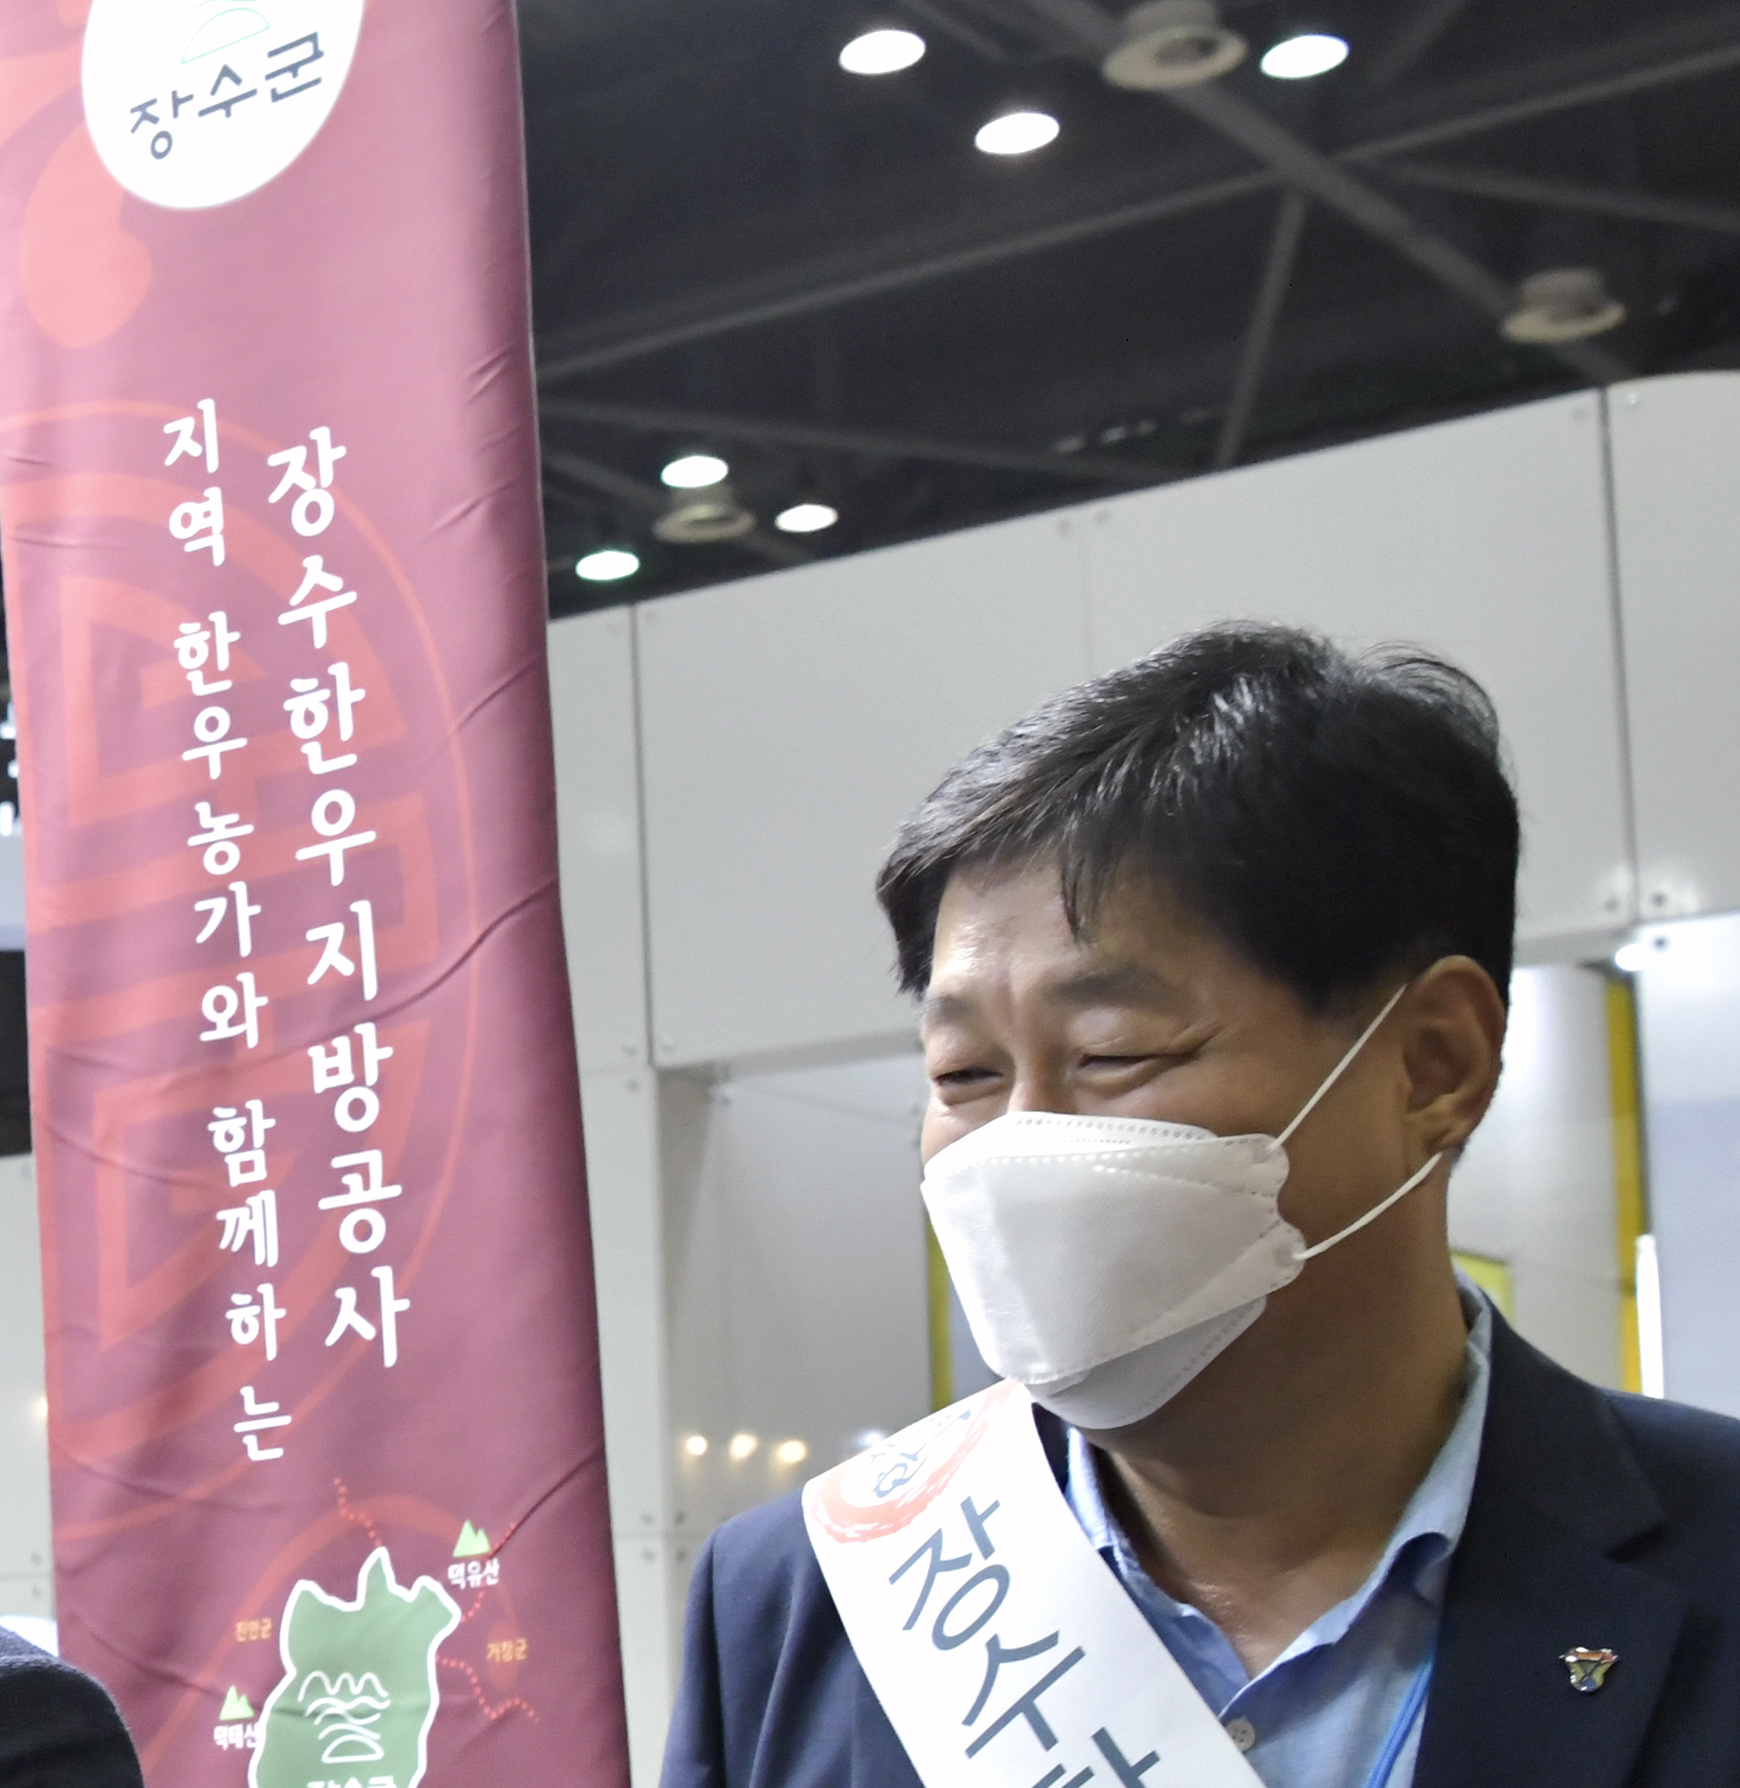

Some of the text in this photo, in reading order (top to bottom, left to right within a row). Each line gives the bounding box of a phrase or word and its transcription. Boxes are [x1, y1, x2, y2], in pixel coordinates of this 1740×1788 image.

[130, 31, 324, 160] 장수군
[163, 398, 292, 1461] 지역 한우농가와 함께하는
[268, 426, 410, 1367] 장수한우지방공사
[448, 1557, 500, 1590] 덕유산
